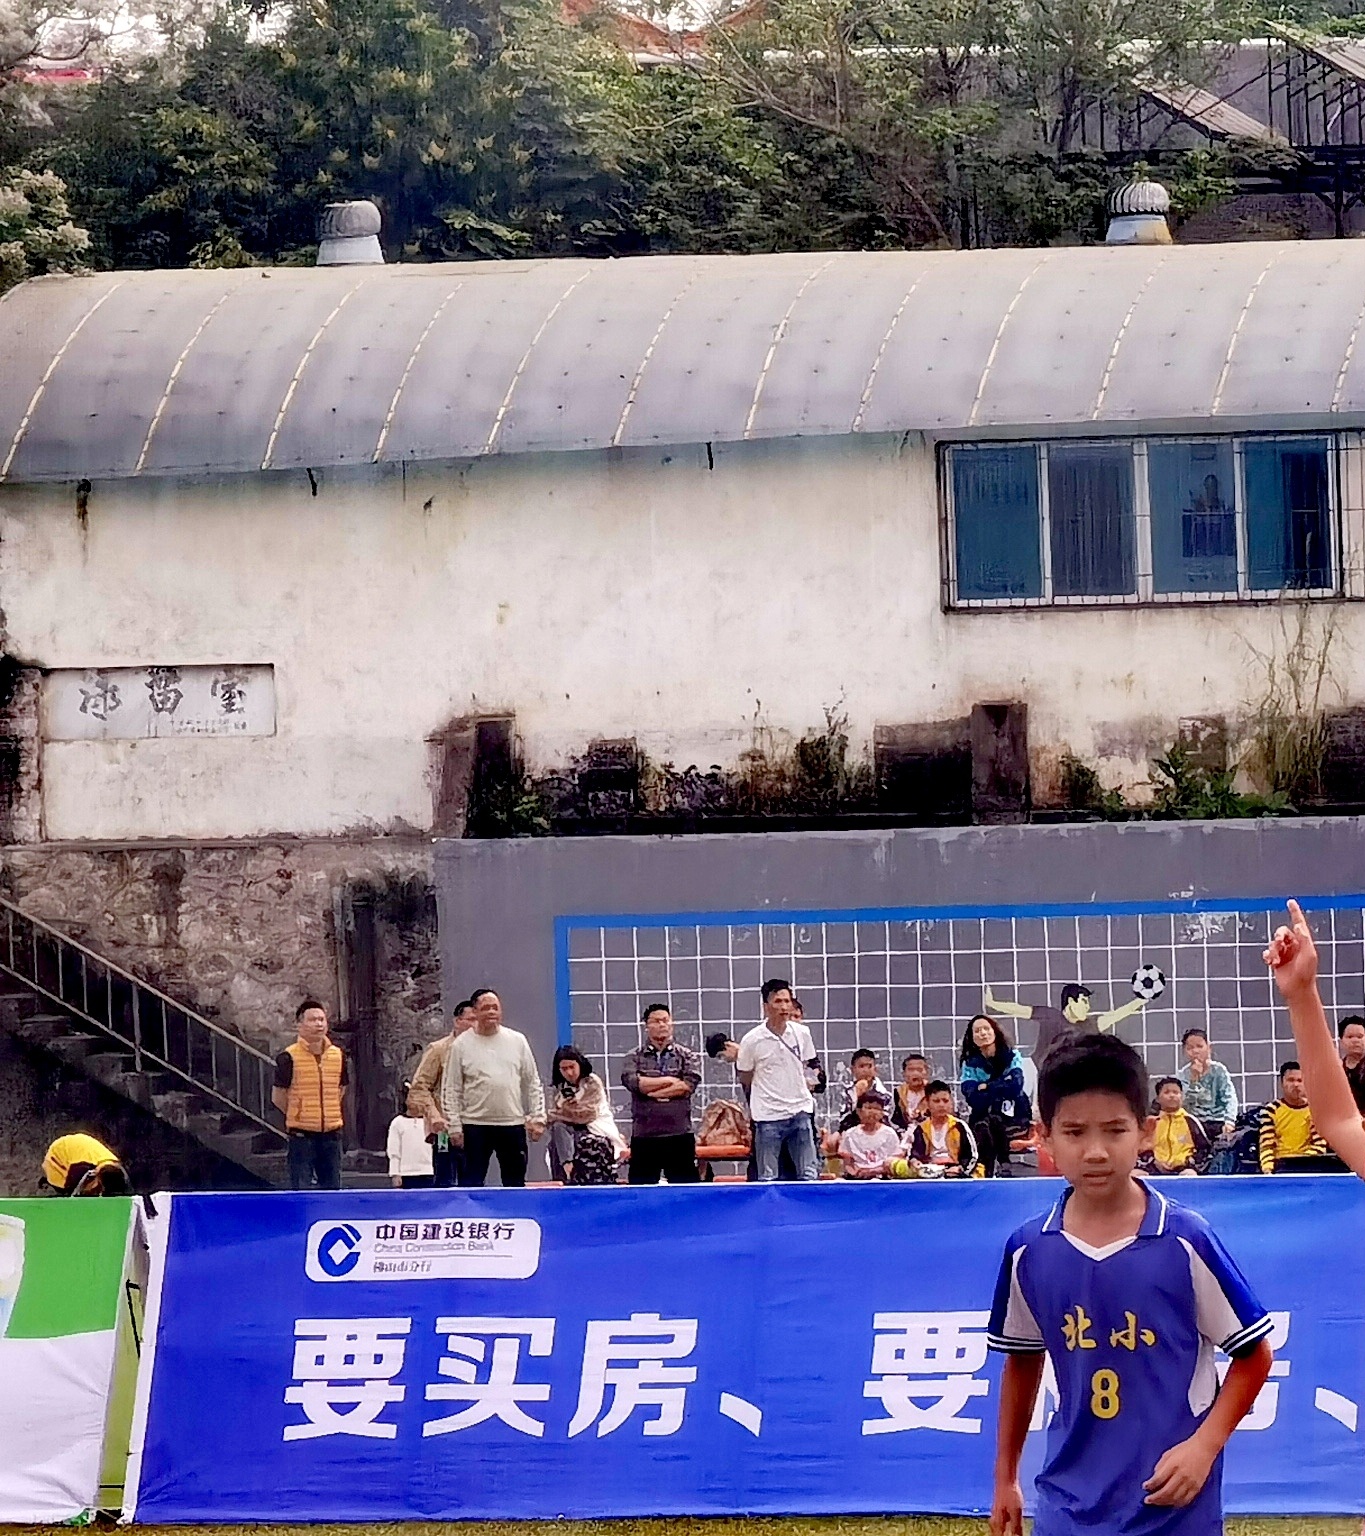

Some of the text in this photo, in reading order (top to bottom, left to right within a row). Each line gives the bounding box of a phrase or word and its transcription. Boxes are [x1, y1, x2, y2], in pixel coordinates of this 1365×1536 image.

[375, 1221, 515, 1241] 中国建设银行
[1060, 1304, 1157, 1352] 北小
[1091, 1368, 1122, 1419] 8
